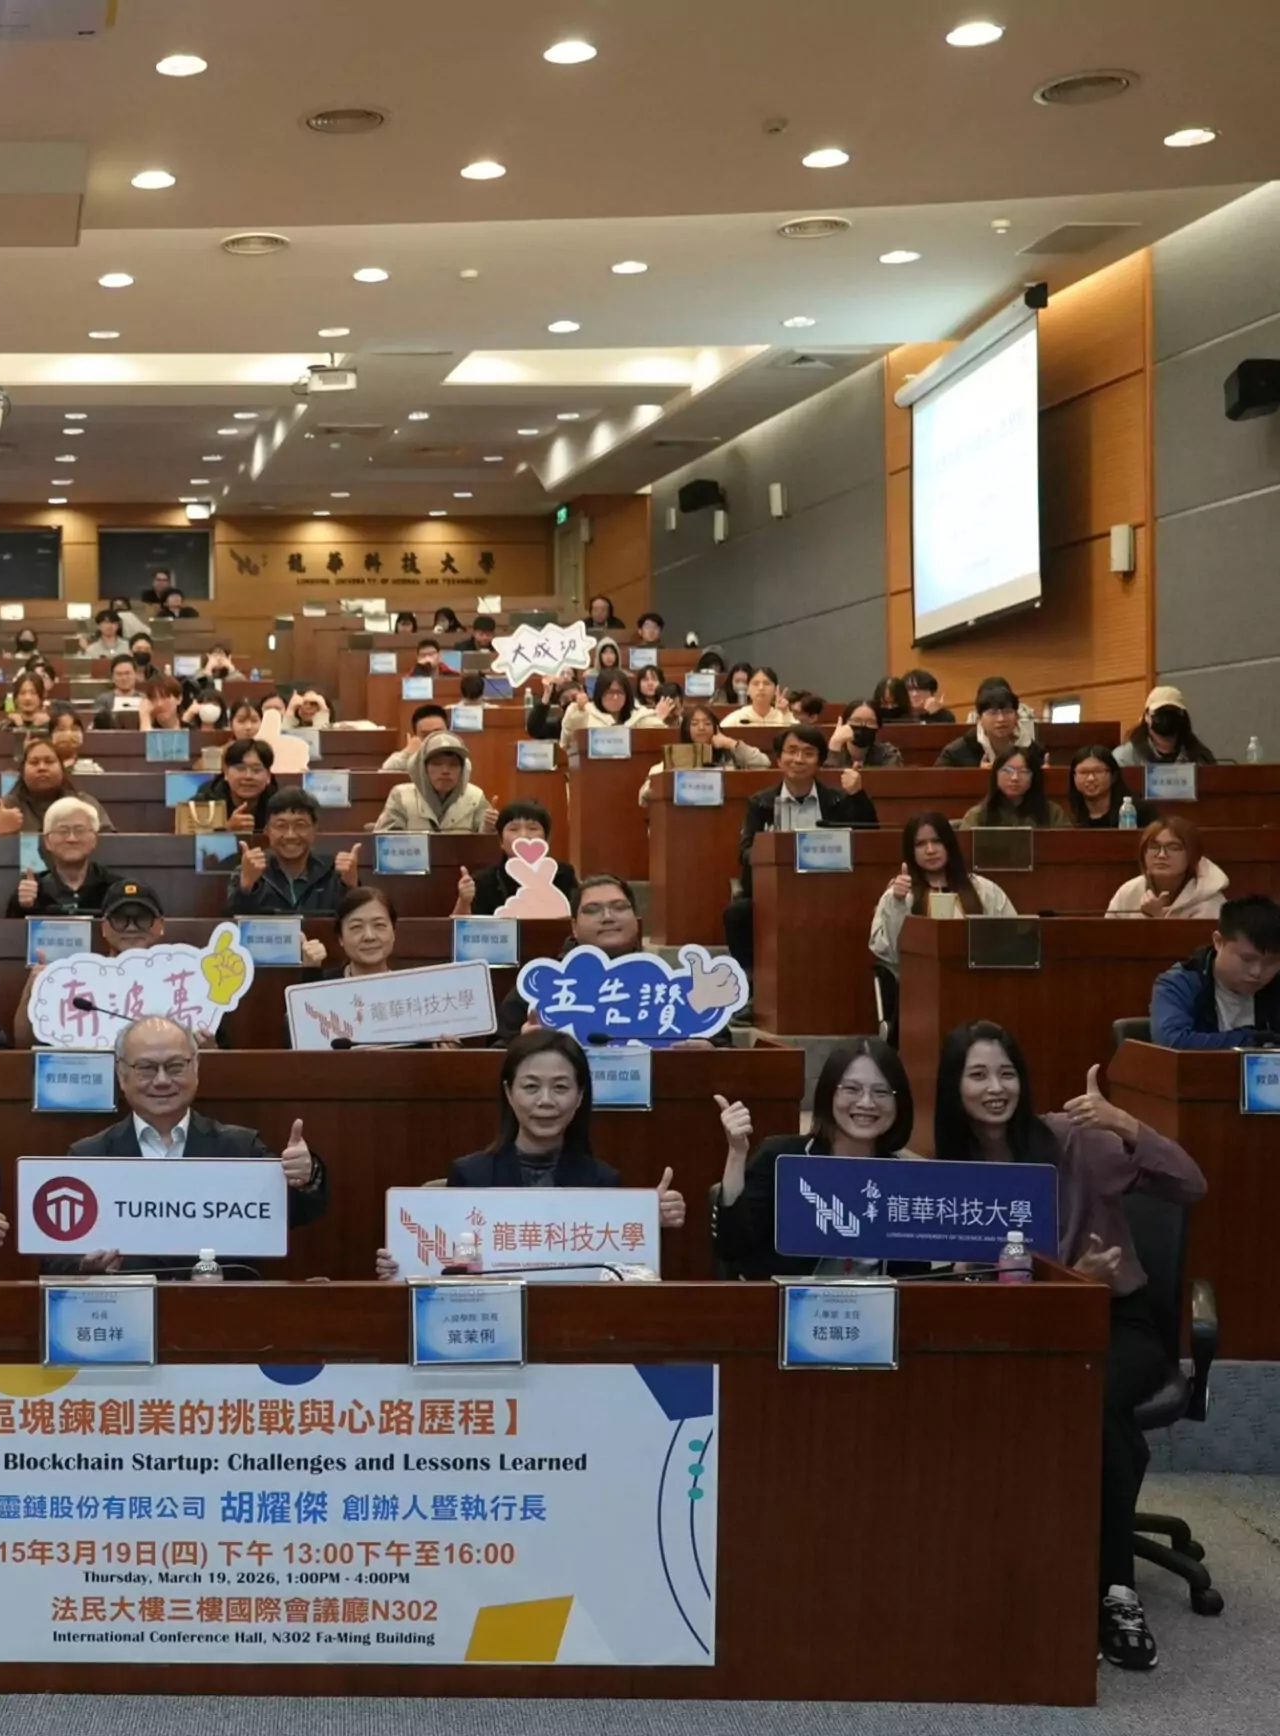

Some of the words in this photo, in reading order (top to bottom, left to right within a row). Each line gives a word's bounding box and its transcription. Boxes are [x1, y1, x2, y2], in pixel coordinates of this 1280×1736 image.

[287, 551, 496, 575] 龍華科技大學
[511, 637, 577, 664] 大成功
[370, 988, 475, 1022] 龍華科技大學
[544, 977, 686, 1036] 五告讚
[114, 1200, 197, 1219] TURING
[202, 1201, 271, 1219] SPACE
[886, 1195, 1033, 1228] 龍華科技大學
[492, 1221, 646, 1252] 龍華科技大學
[4, 1452, 124, 1472] Blockchain
[131, 1453, 219, 1475] Startup:
[227, 1453, 347, 1474] Challenges
[354, 1454, 395, 1471] and
[403, 1454, 491, 1472] Lessons
[499, 1453, 588, 1472] Learned
[220, 1490, 329, 1525] 胡耀傑
[342, 1494, 548, 1523] 創辦人暨執行長
[218, 1540, 273, 1567] 下午
[283, 1540, 516, 1567] 13:00下午至16:00
[83, 1570, 153, 1586] Thursday,
[157, 1570, 202, 1584] March
[208, 1571, 232, 1587] 19,
[236, 1571, 280, 1587] 2026,
[286, 1571, 341, 1584] 1:00PM
[354, 1571, 411, 1585] 4:00PM
[50, 1597, 438, 1624] 法民大樓三樓國際會議廳N302
[52, 1630, 145, 1644] International
[149, 1630, 230, 1645] Conference
[235, 1631, 268, 1647] Hall,
[272, 1632, 311, 1645] N302
[317, 1631, 371, 1647] Fa-Ming
[375, 1631, 436, 1647] Building
